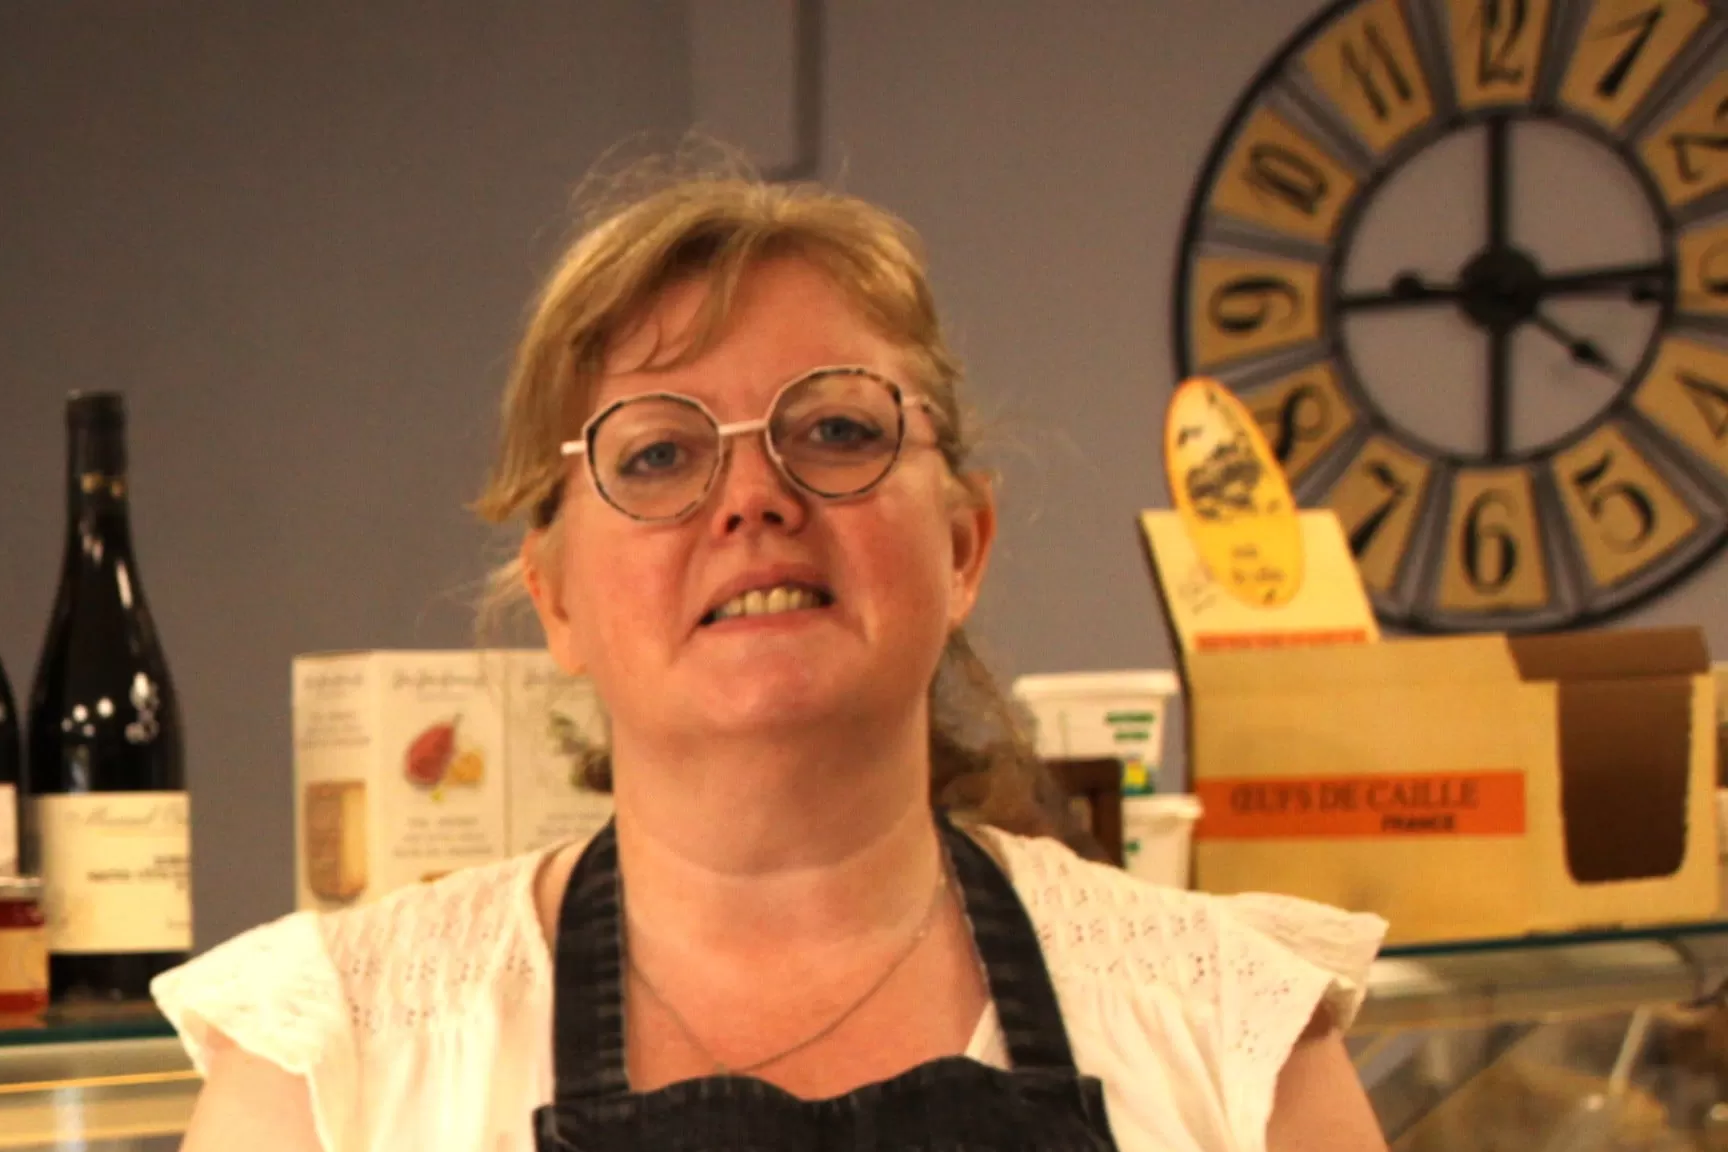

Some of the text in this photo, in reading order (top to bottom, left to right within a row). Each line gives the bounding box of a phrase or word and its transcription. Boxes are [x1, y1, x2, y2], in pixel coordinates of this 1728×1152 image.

[1572, 450, 1658, 555] 5
[1460, 488, 1518, 595] 6
[1318, 781, 1357, 813] DE
[1366, 777, 1480, 813] CAILLE
[1380, 813, 1456, 832] FRANCE
